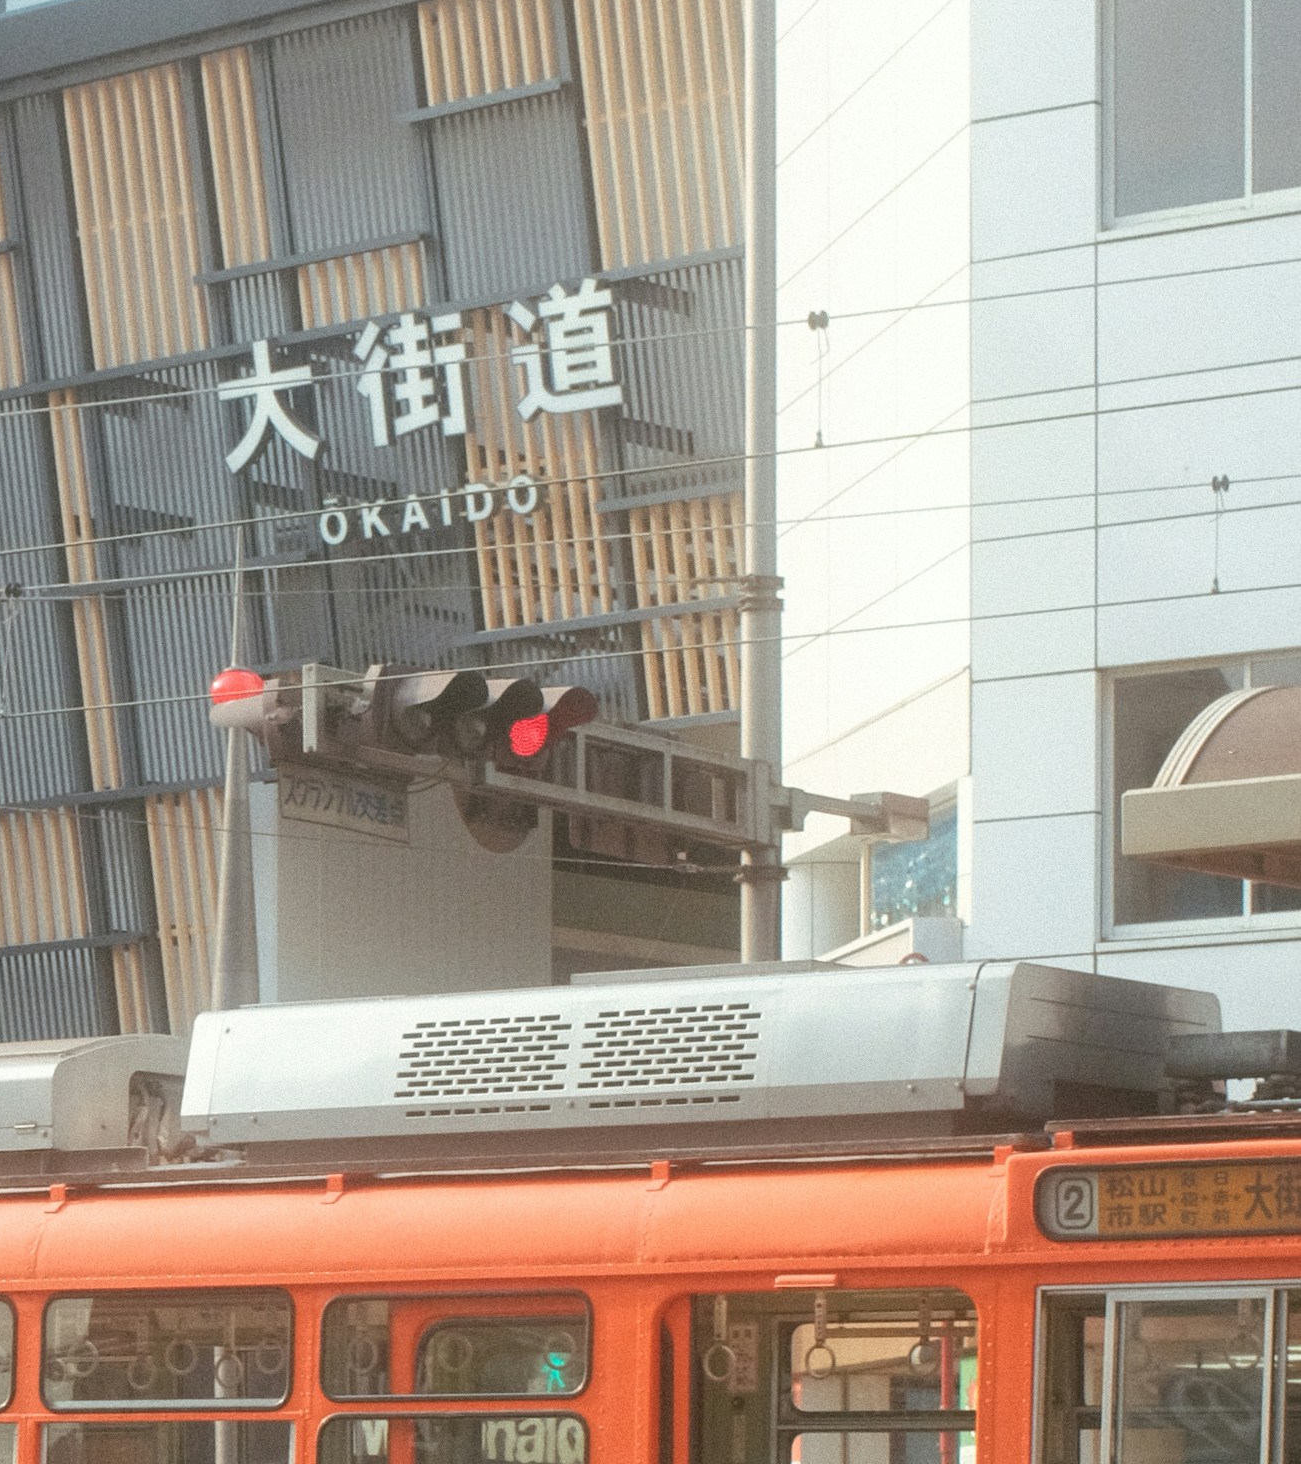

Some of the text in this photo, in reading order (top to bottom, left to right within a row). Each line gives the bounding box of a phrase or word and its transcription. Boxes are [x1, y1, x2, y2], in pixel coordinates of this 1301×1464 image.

[218, 278, 622, 473] 大街道
[1064, 1186, 1085, 1221] 2
